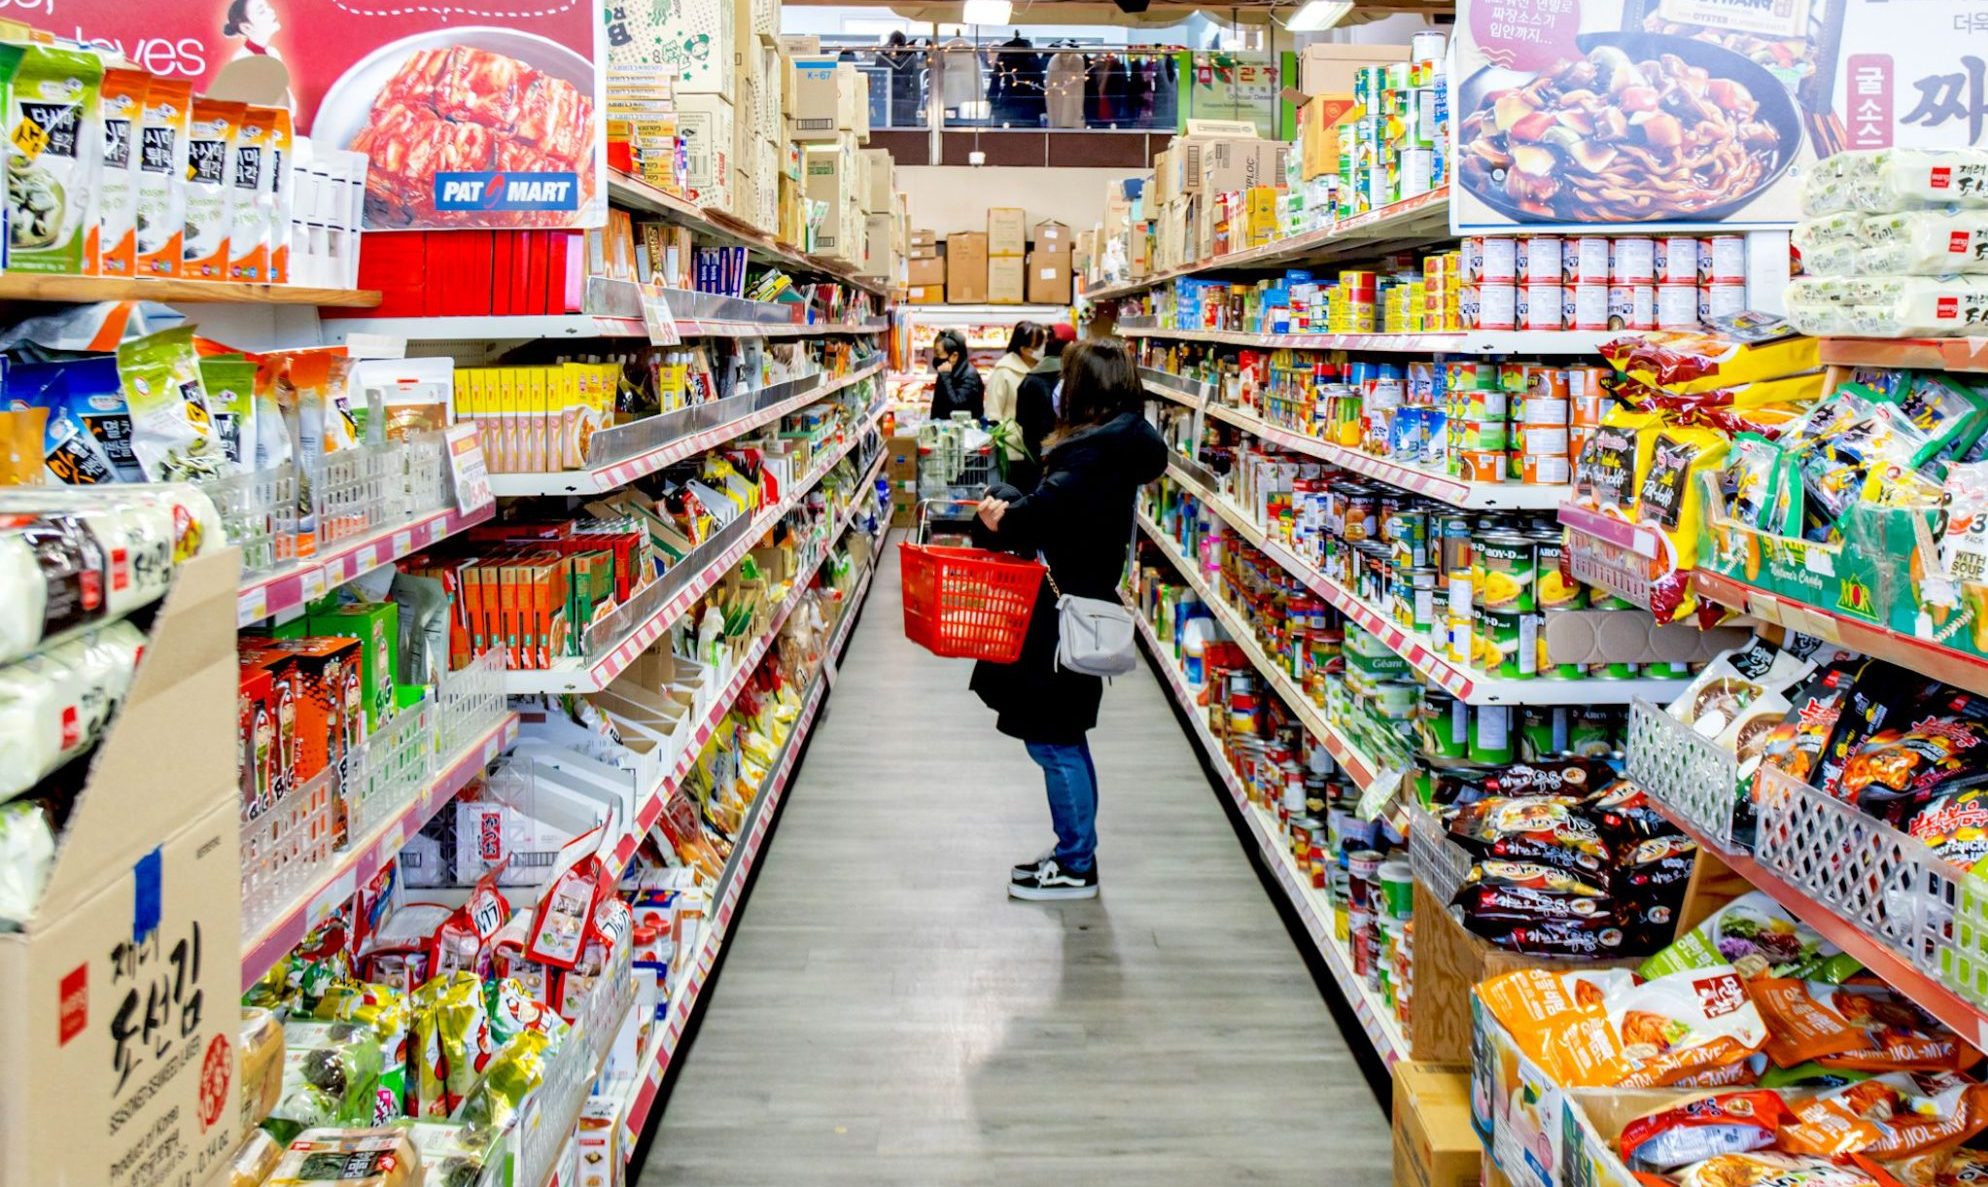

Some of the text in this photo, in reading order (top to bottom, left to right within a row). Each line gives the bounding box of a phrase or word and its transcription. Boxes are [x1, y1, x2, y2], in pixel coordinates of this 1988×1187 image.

[807, 71, 832, 81] K-67
[1855, 65, 1885, 145] 굴소스
[443, 181, 571, 203] PAT MART
[1969, 513, 1987, 533] 3
[1954, 549, 1987, 566] WITH
[1951, 562, 1985, 577] SOUP
[1840, 578, 1871, 613] MOR
[484, 816, 499, 855] かつお
